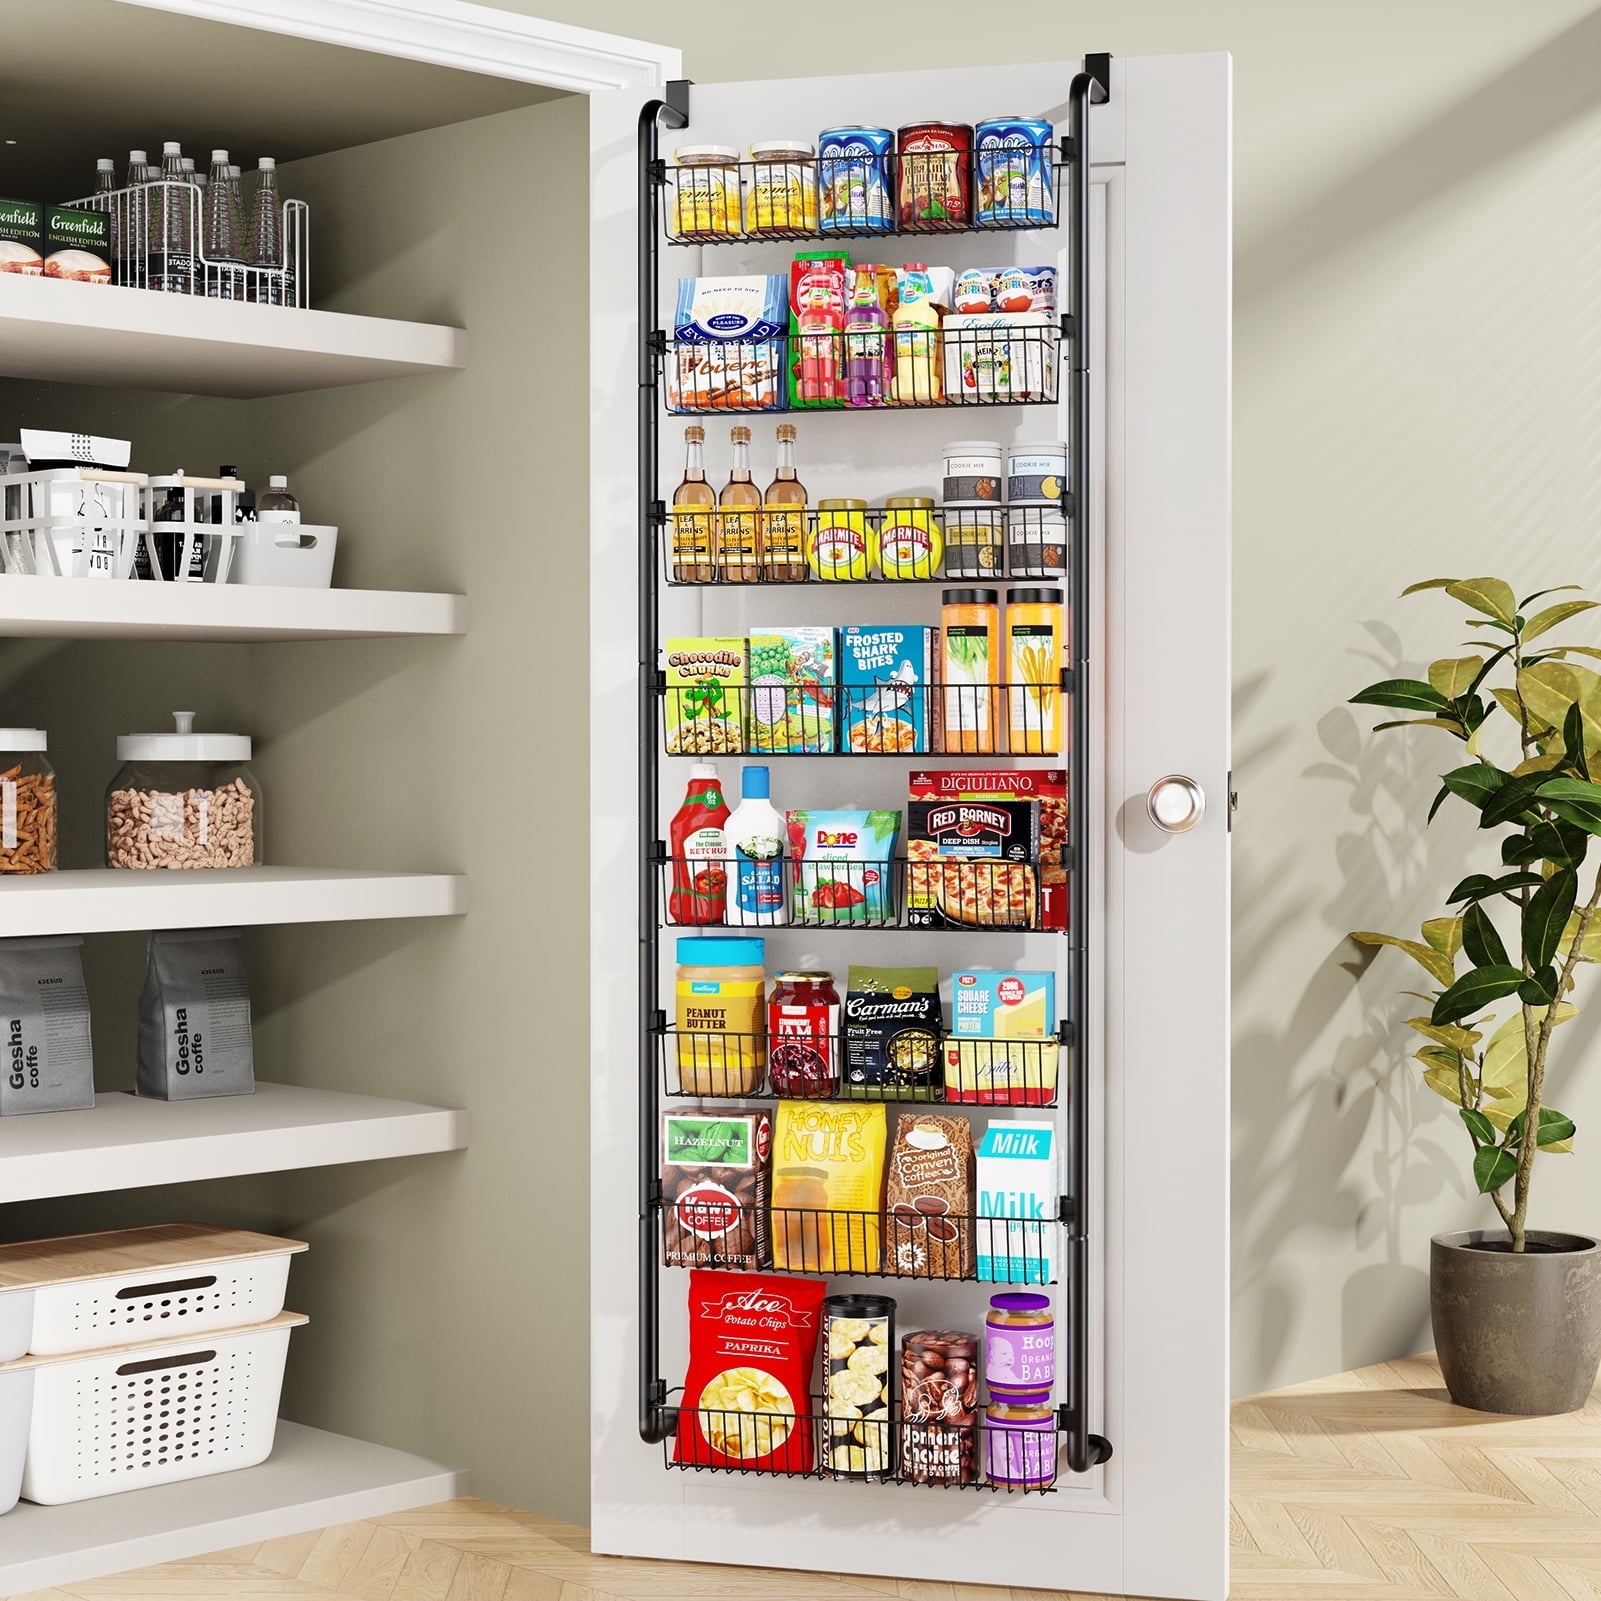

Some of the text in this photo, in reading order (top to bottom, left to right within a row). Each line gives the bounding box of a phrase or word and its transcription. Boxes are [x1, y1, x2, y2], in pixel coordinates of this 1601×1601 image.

[51, 215, 104, 235] Greenfield
[48, 233, 78, 243] ENGLISH
[79, 238, 108, 247] EDITION
[977, 347, 999, 357] HEINZ
[700, 360, 767, 375] bueno
[882, 526, 929, 544] MARMITE
[846, 632, 904, 647] FROSTED
[853, 644, 898, 658] SHARK
[669, 651, 742, 667] Chocodile
[858, 655, 894, 671] BITES
[679, 664, 731, 678] Chunks
[706, 791, 717, 800] 64
[932, 807, 1006, 829] RED BARNEY
[741, 875, 780, 885] SALAD
[957, 990, 990, 1002] SQUARE
[686, 1008, 726, 1018] PEANUT
[847, 997, 930, 1017] Carman's
[957, 1002, 989, 1014] CHEESE
[686, 1018, 726, 1029] BUTTER
[778, 1025, 812, 1040] JAM
[174, 1008, 190, 1075] Gesha
[8, 1019, 25, 1090] Gesha
[191, 1033, 204, 1074] coffe
[26, 1045, 39, 1088] coffe
[786, 1110, 873, 1133] HONEY
[673, 1136, 744, 1147] HAZELNUT
[991, 1132, 1040, 1155] Milk
[917, 1148, 950, 1161] original
[904, 1171, 938, 1182] coffee
[685, 1196, 732, 1215] Kawa
[980, 1191, 1045, 1219] Milk
[726, 1288, 786, 1313] Ace
[724, 1314, 787, 1331] Potato Chips
[724, 1341, 781, 1355] PAPRIKA
